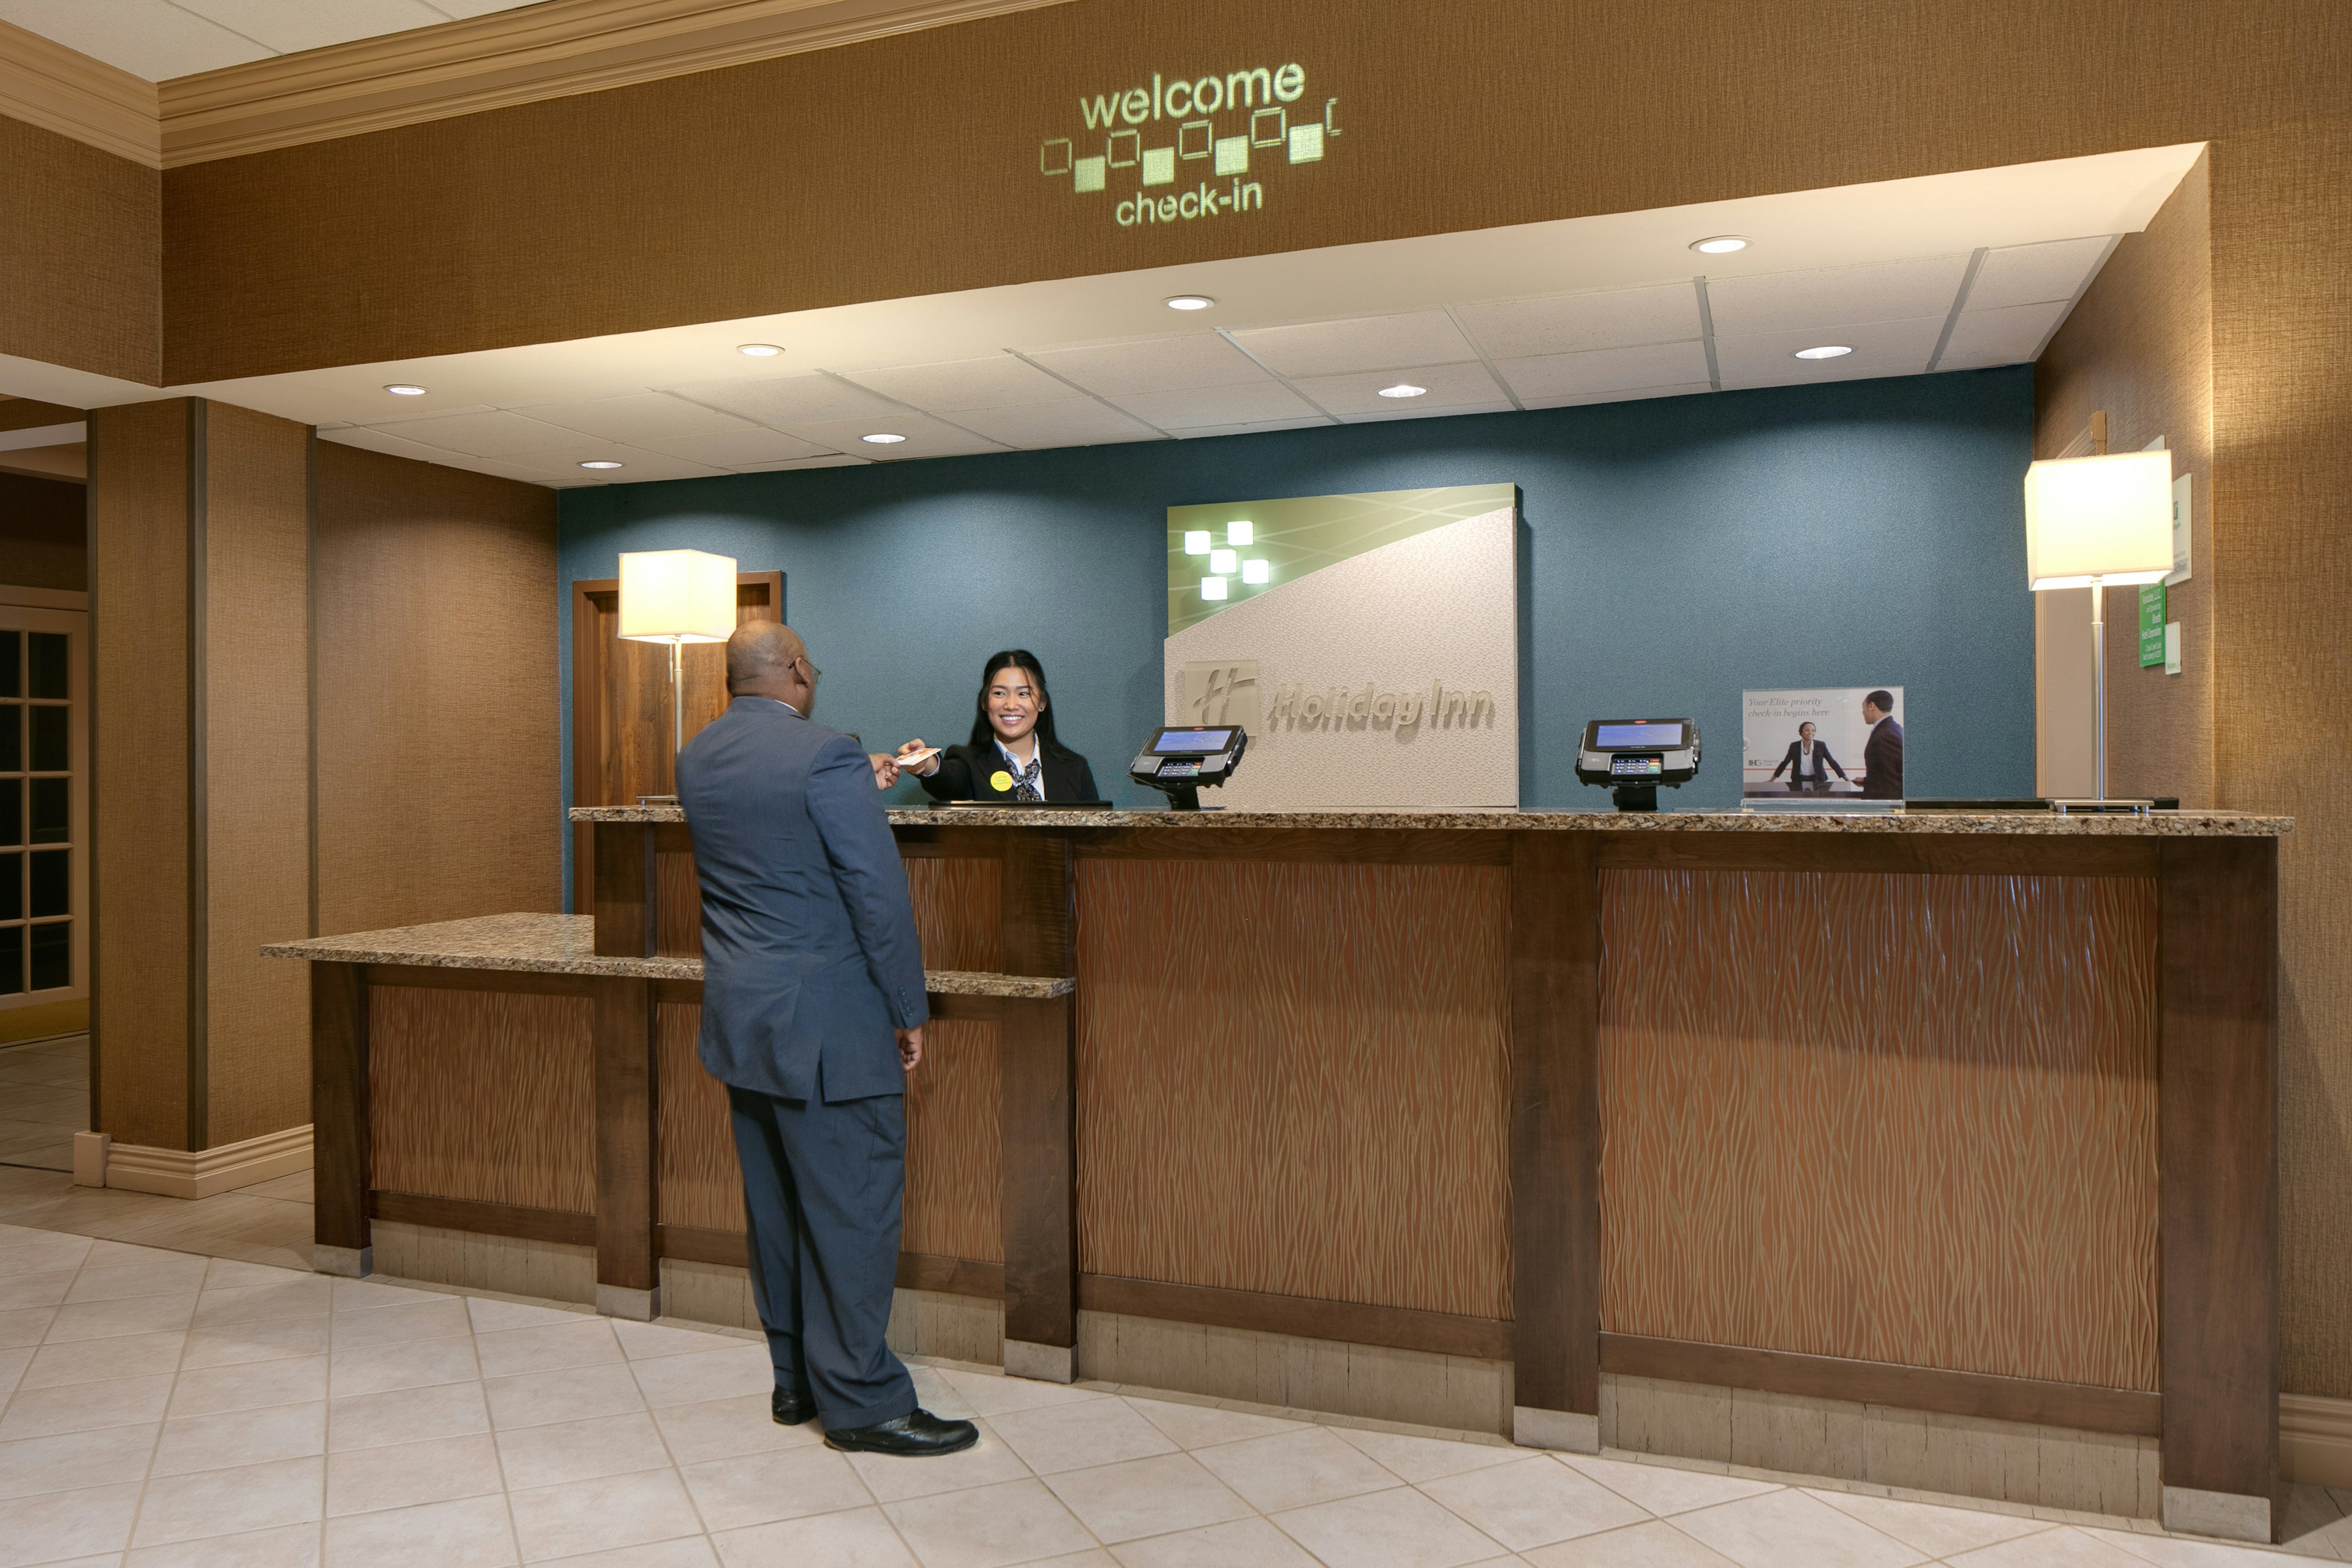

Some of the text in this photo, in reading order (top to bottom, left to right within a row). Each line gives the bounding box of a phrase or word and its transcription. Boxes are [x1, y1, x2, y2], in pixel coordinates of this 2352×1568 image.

[1080, 62, 1305, 130] welcome
[1115, 177, 1262, 226] check-in
[1272, 679, 1491, 725] Holiday Inn
[1747, 709, 1782, 717] check-in
[1783, 709, 1810, 718] begins
[1770, 698, 1789, 706] Elite
[1790, 697, 1823, 707] priority
